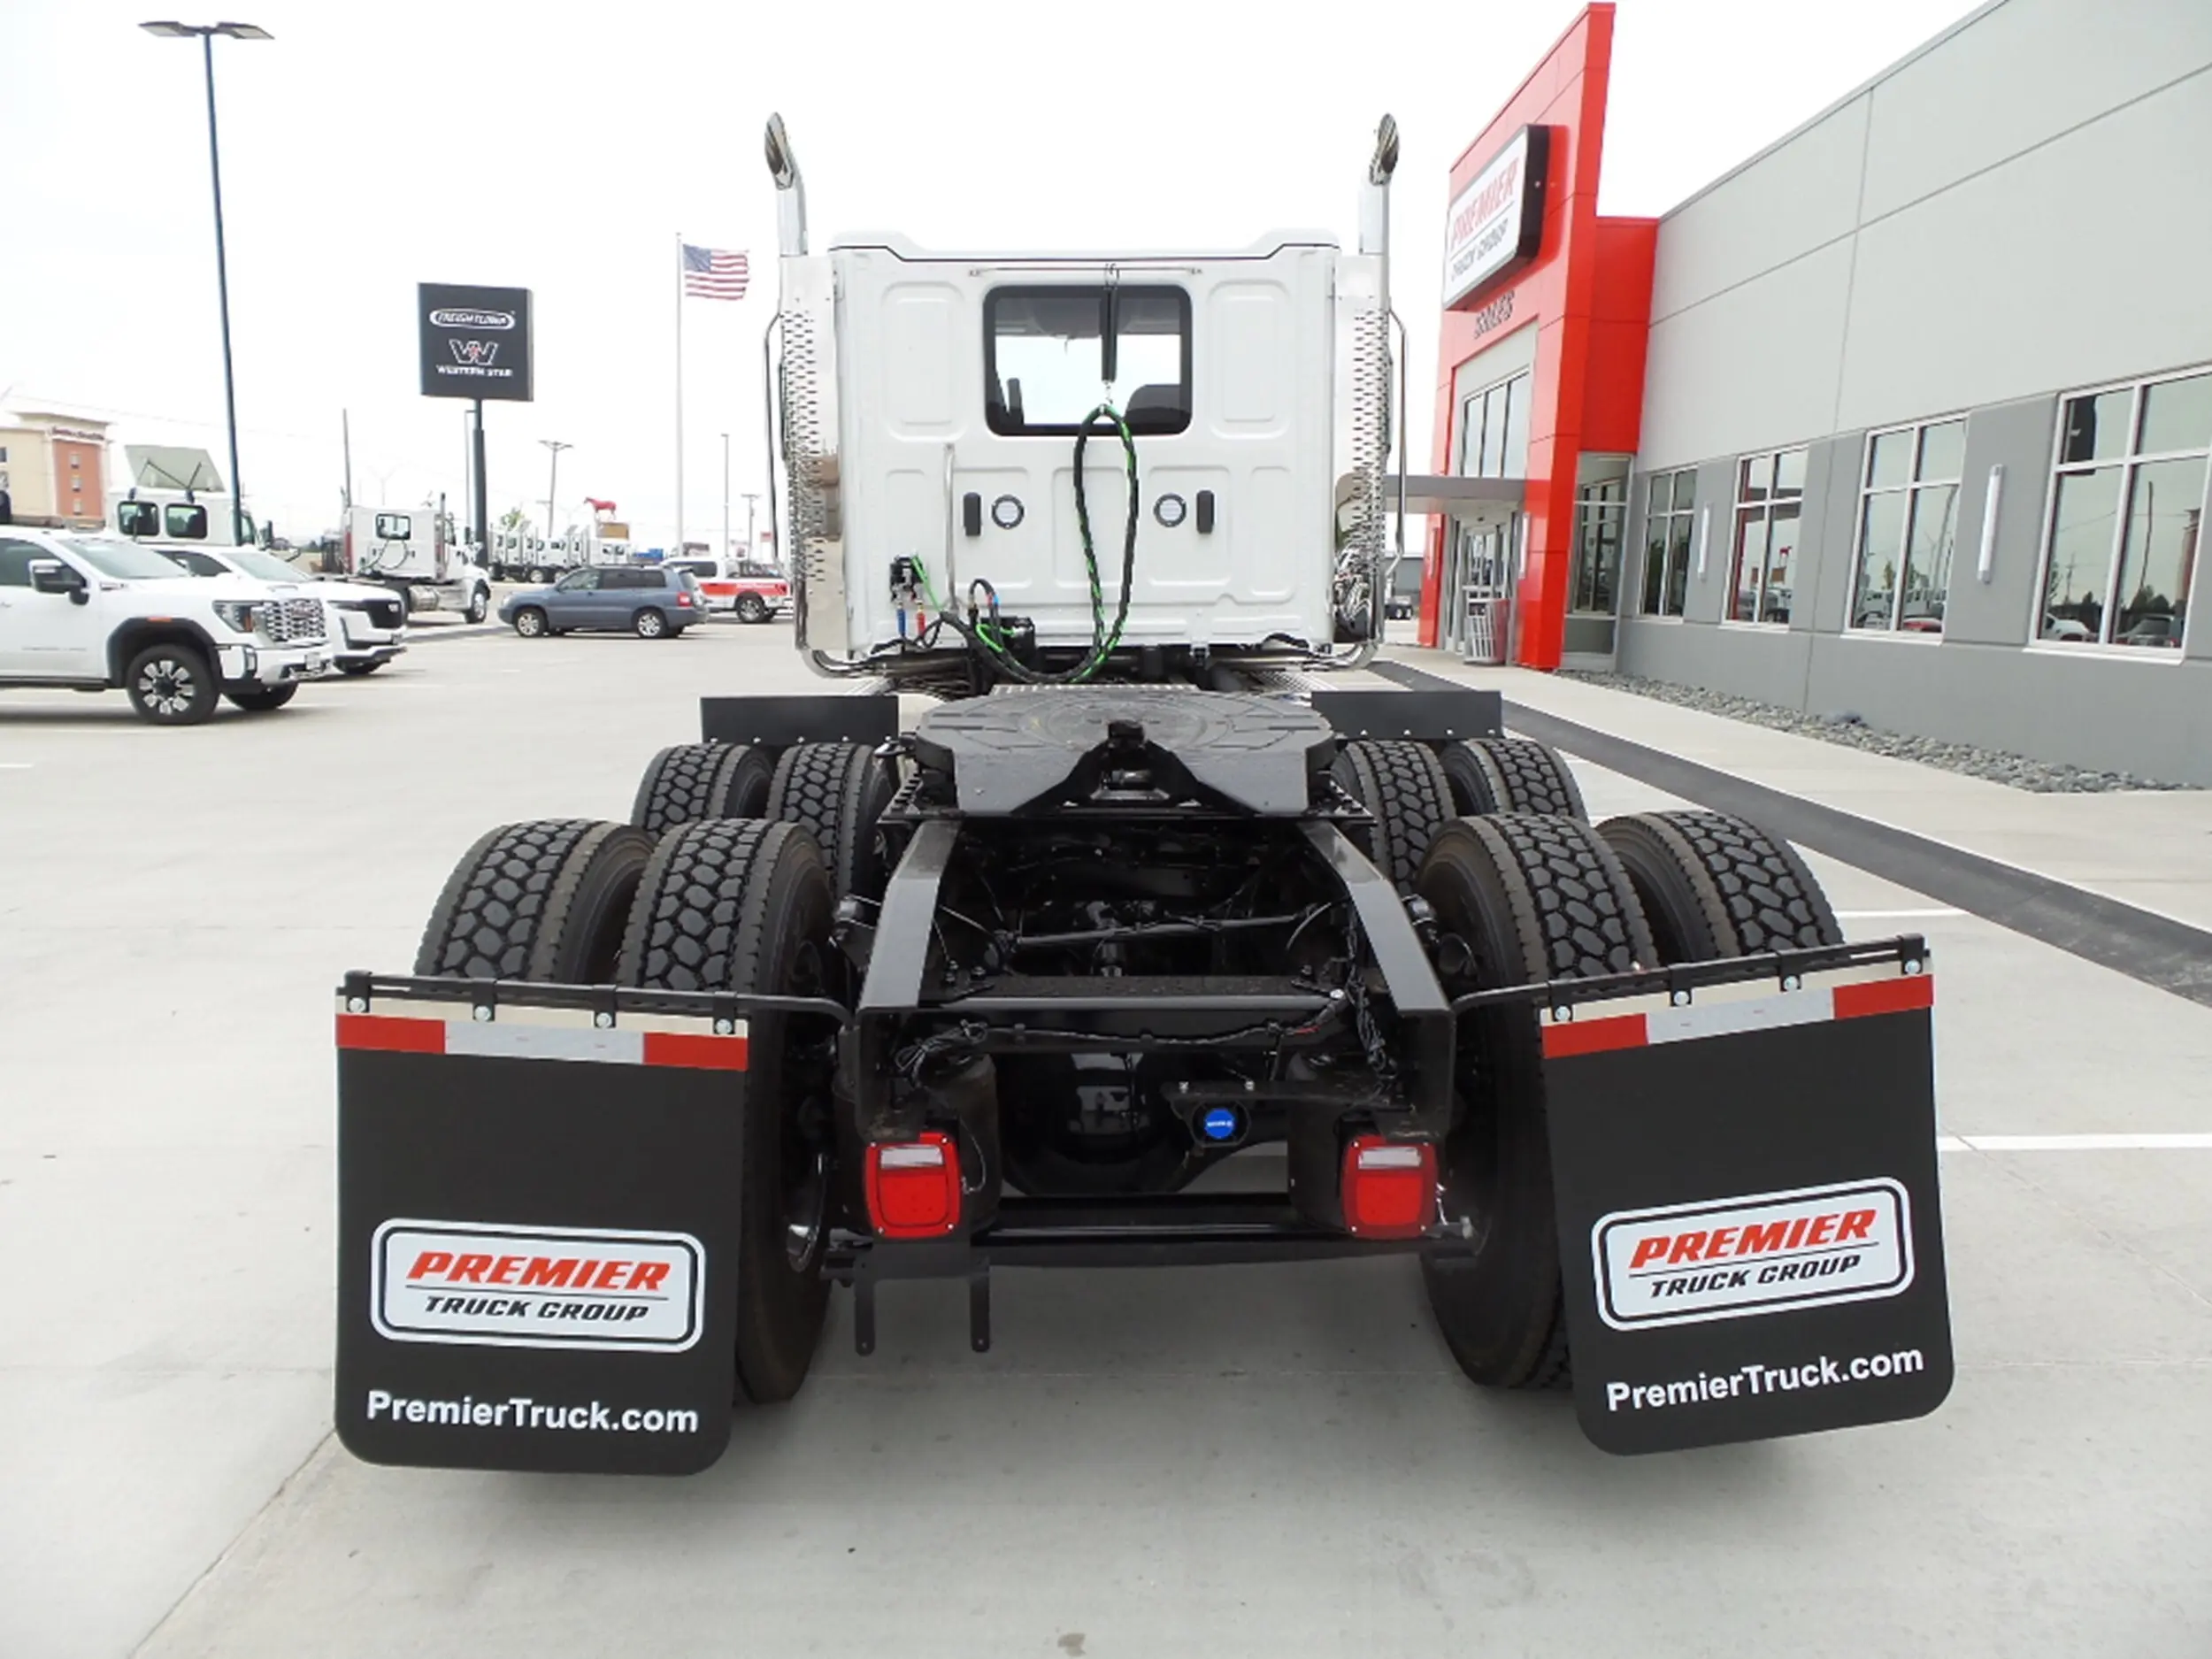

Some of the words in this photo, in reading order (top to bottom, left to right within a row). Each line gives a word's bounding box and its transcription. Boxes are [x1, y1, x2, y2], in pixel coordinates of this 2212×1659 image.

[1629, 1210, 1878, 1269] PREMIER
[406, 1251, 671, 1291] PREMIER
[1650, 1270, 1751, 1298] TRUCK
[1757, 1255, 1861, 1285] GROUP
[425, 1296, 532, 1318] TRUCK
[537, 1302, 649, 1322] GROUP
[1607, 1348, 1924, 1411] PremierTruck.com
[366, 1390, 699, 1432] PremierTruck.com
